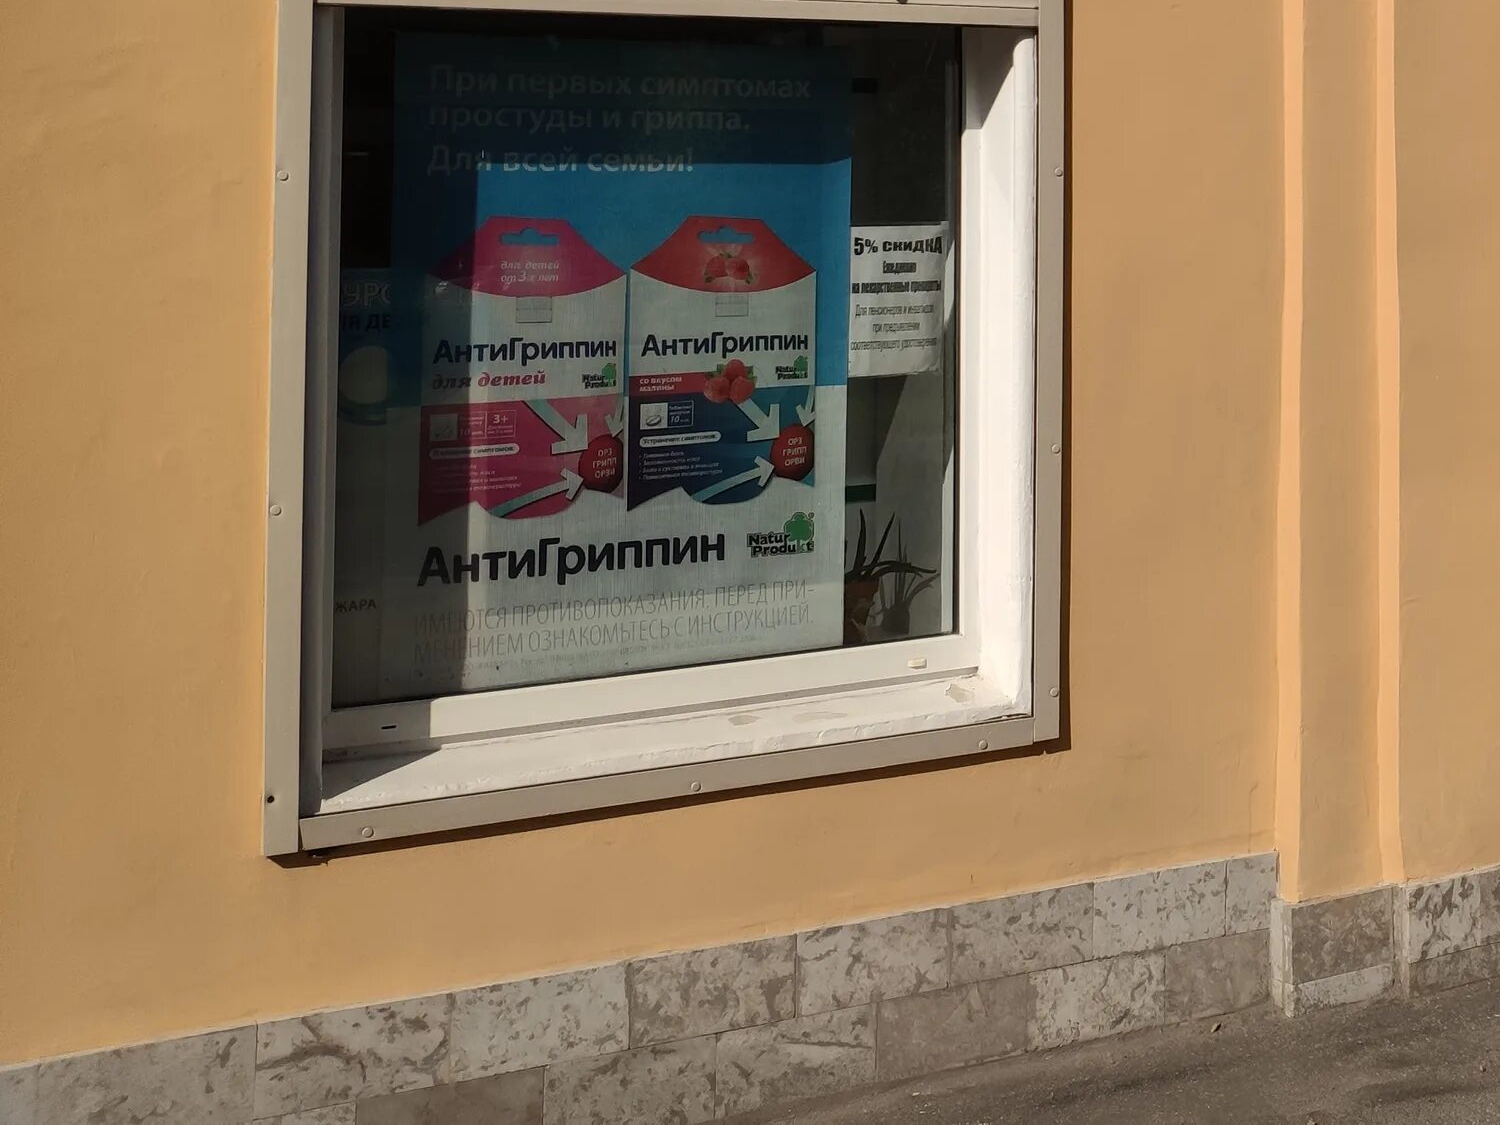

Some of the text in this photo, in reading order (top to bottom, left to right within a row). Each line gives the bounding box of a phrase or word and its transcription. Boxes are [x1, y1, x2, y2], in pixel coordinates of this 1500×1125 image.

[432, 65, 813, 101] При первых симптомах
[430, 105, 752, 136] простуды и гриппа.
[428, 144, 696, 177] Для всей семьи!
[854, 236, 879, 256] 5%
[432, 336, 617, 366] АнтиГриппин
[640, 330, 809, 359] АнтиГриппин
[431, 369, 546, 390] для детей
[493, 413, 509, 425] 3+
[749, 531, 793, 547] Natur
[419, 532, 728, 588] АнтиГриппин
[415, 578, 817, 636] ИМЕЮТСЯ ПРОТИВОПОКАЗАНИЯ. ПЕРЕД ПРИ-
[415, 630, 527, 665] МЕНЕНИЕМ
[530, 622, 672, 655] ОЗНАКОМЬТЕСЬ
[675, 617, 688, 638] С
[690, 597, 817, 635] ИНСТРУКЦИЕЙ.
